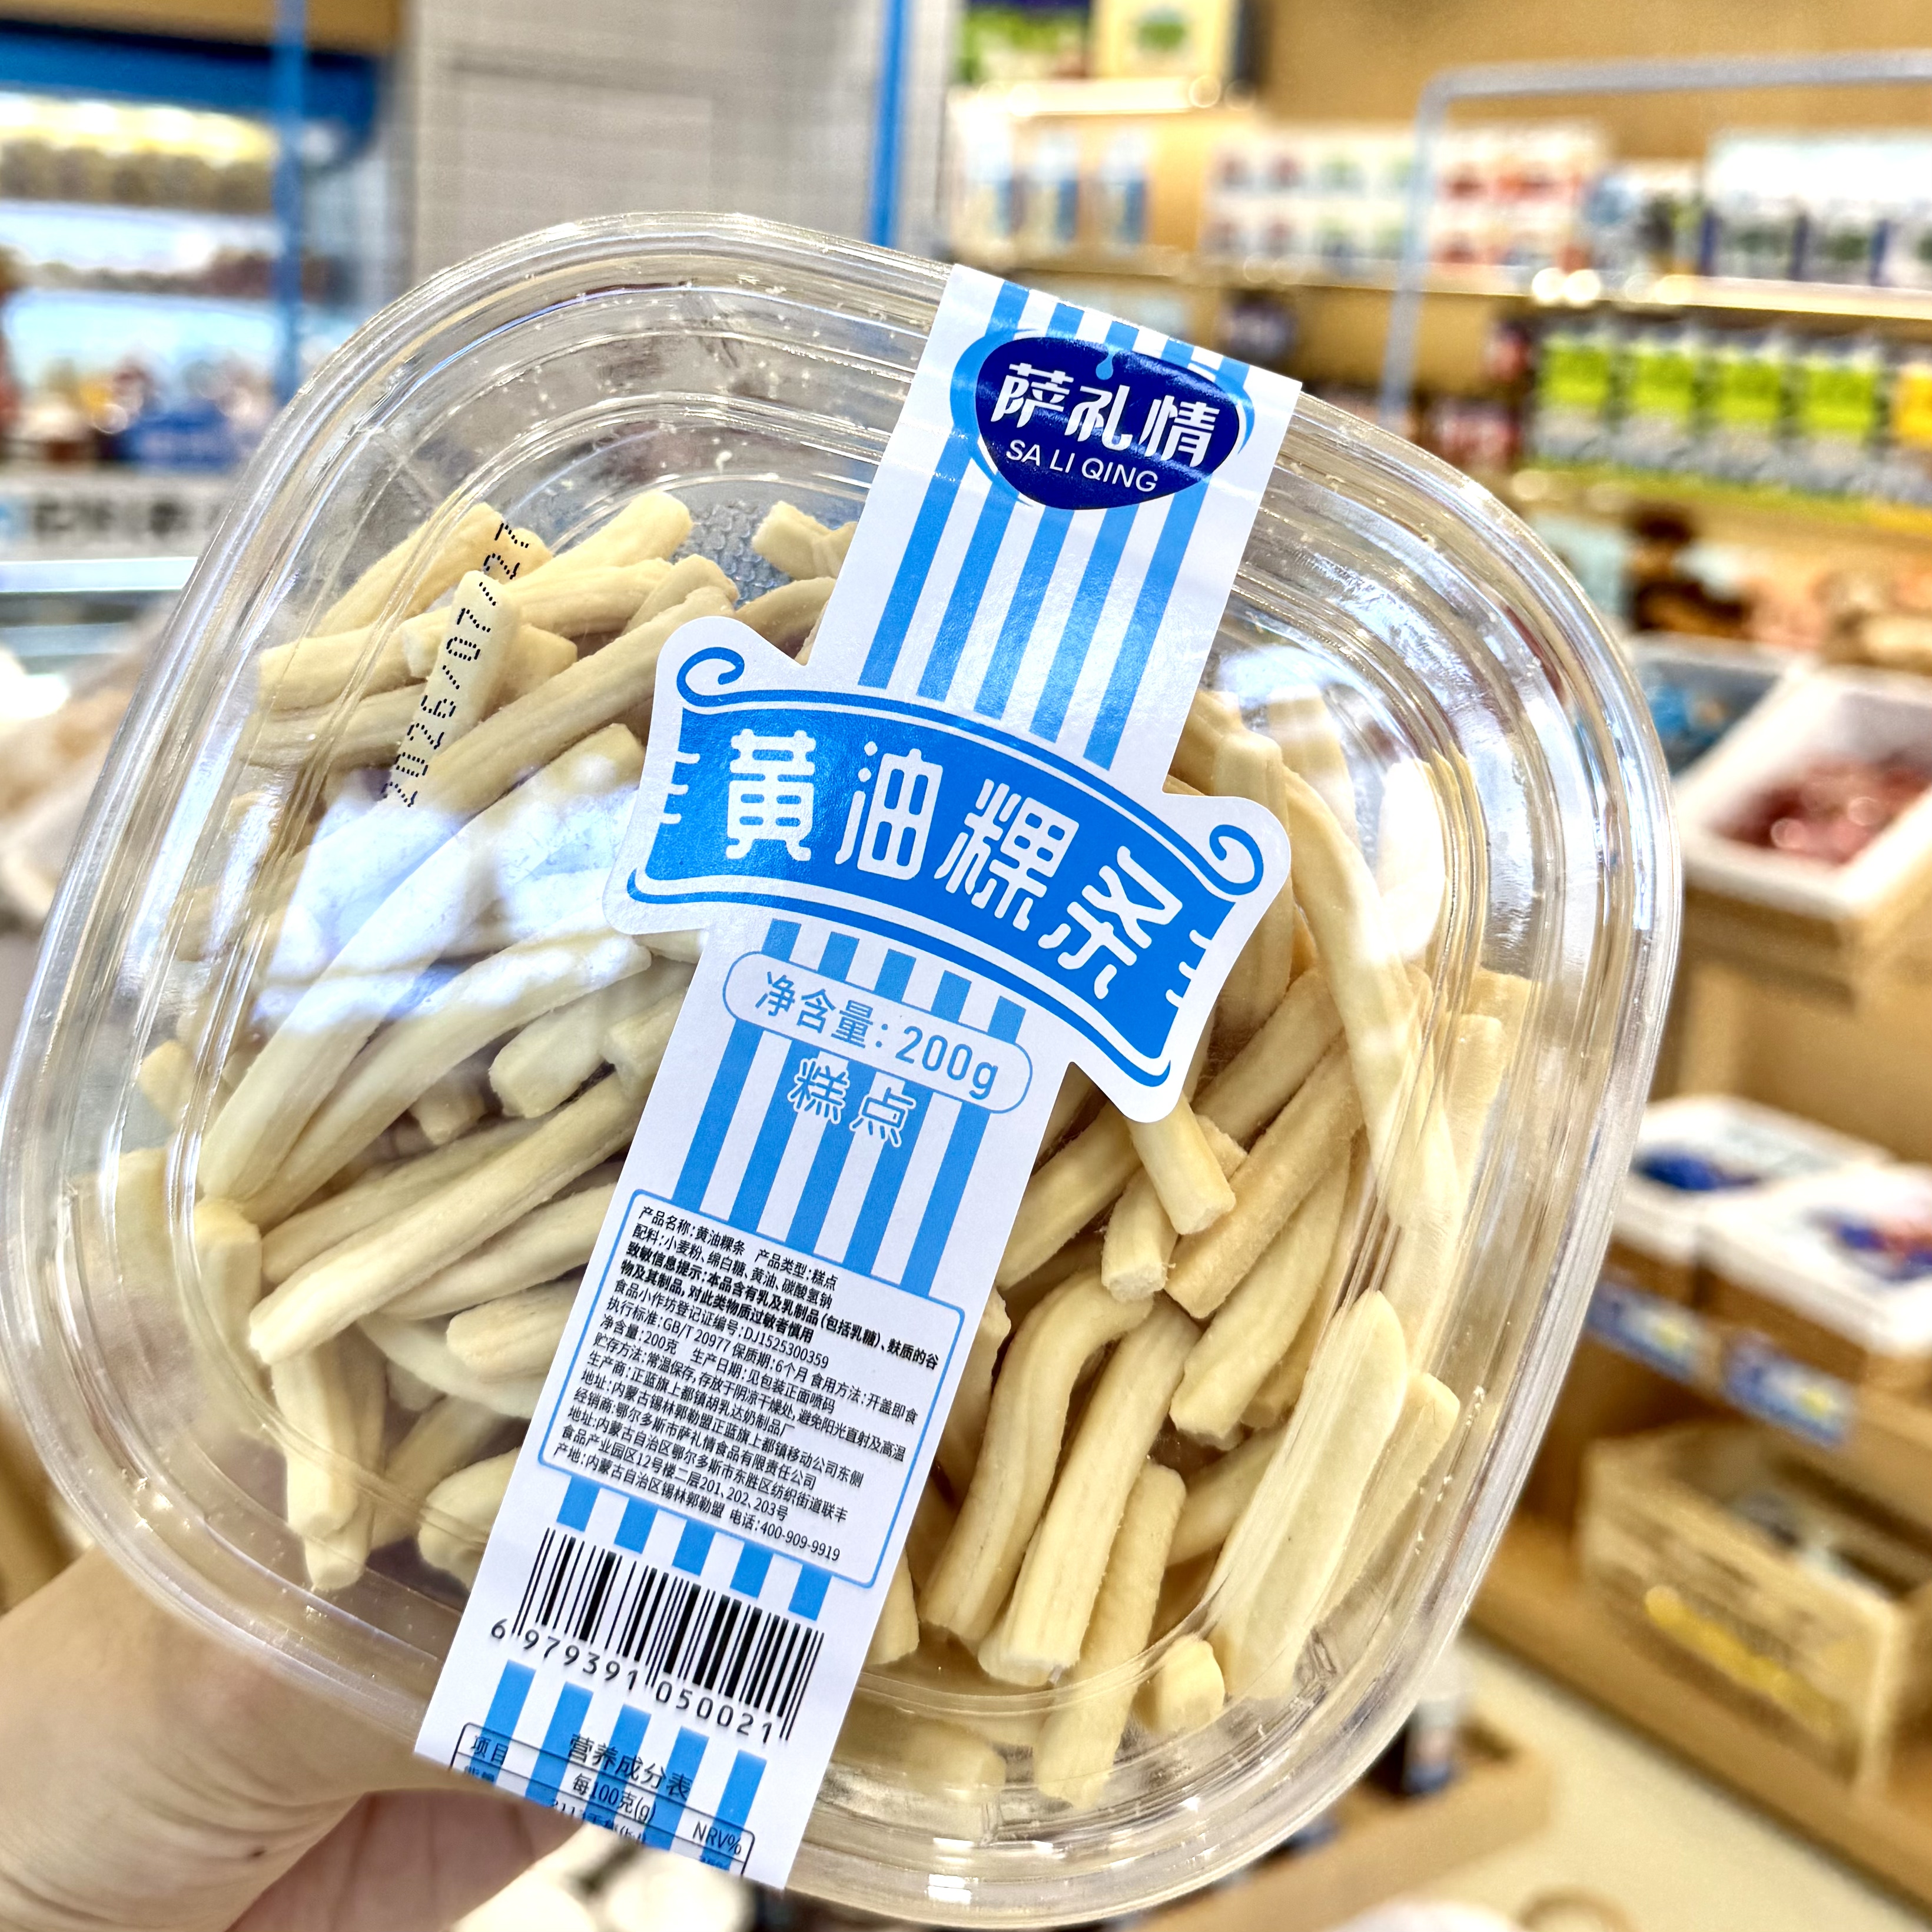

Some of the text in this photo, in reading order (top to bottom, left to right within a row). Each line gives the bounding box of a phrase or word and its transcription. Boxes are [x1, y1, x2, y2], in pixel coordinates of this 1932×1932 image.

[990, 363, 1220, 467] 萨礼情
[1005, 439, 1159, 493] SA LI QING
[380, 522, 530, 808] 2026/07/27
[725, 728, 1183, 1001] 黄油粿条
[755, 970, 999, 1099] 净含量：200g
[788, 1057, 917, 1150] 糕点
[638, 1206, 839, 1291] 产品名称：黄油粿条 产品类型：糕点
[599, 1313, 680, 1355] 净含量：200克
[694, 1328, 732, 1353] 20977
[490, 1618, 773, 1745] 6 979391 050021
[470, 1734, 509, 1767] 项目
[572, 1772, 656, 1824] 每100克(g)
[692, 1820, 742, 1855] NRV%
[567, 1733, 695, 1801] 营养成分表
